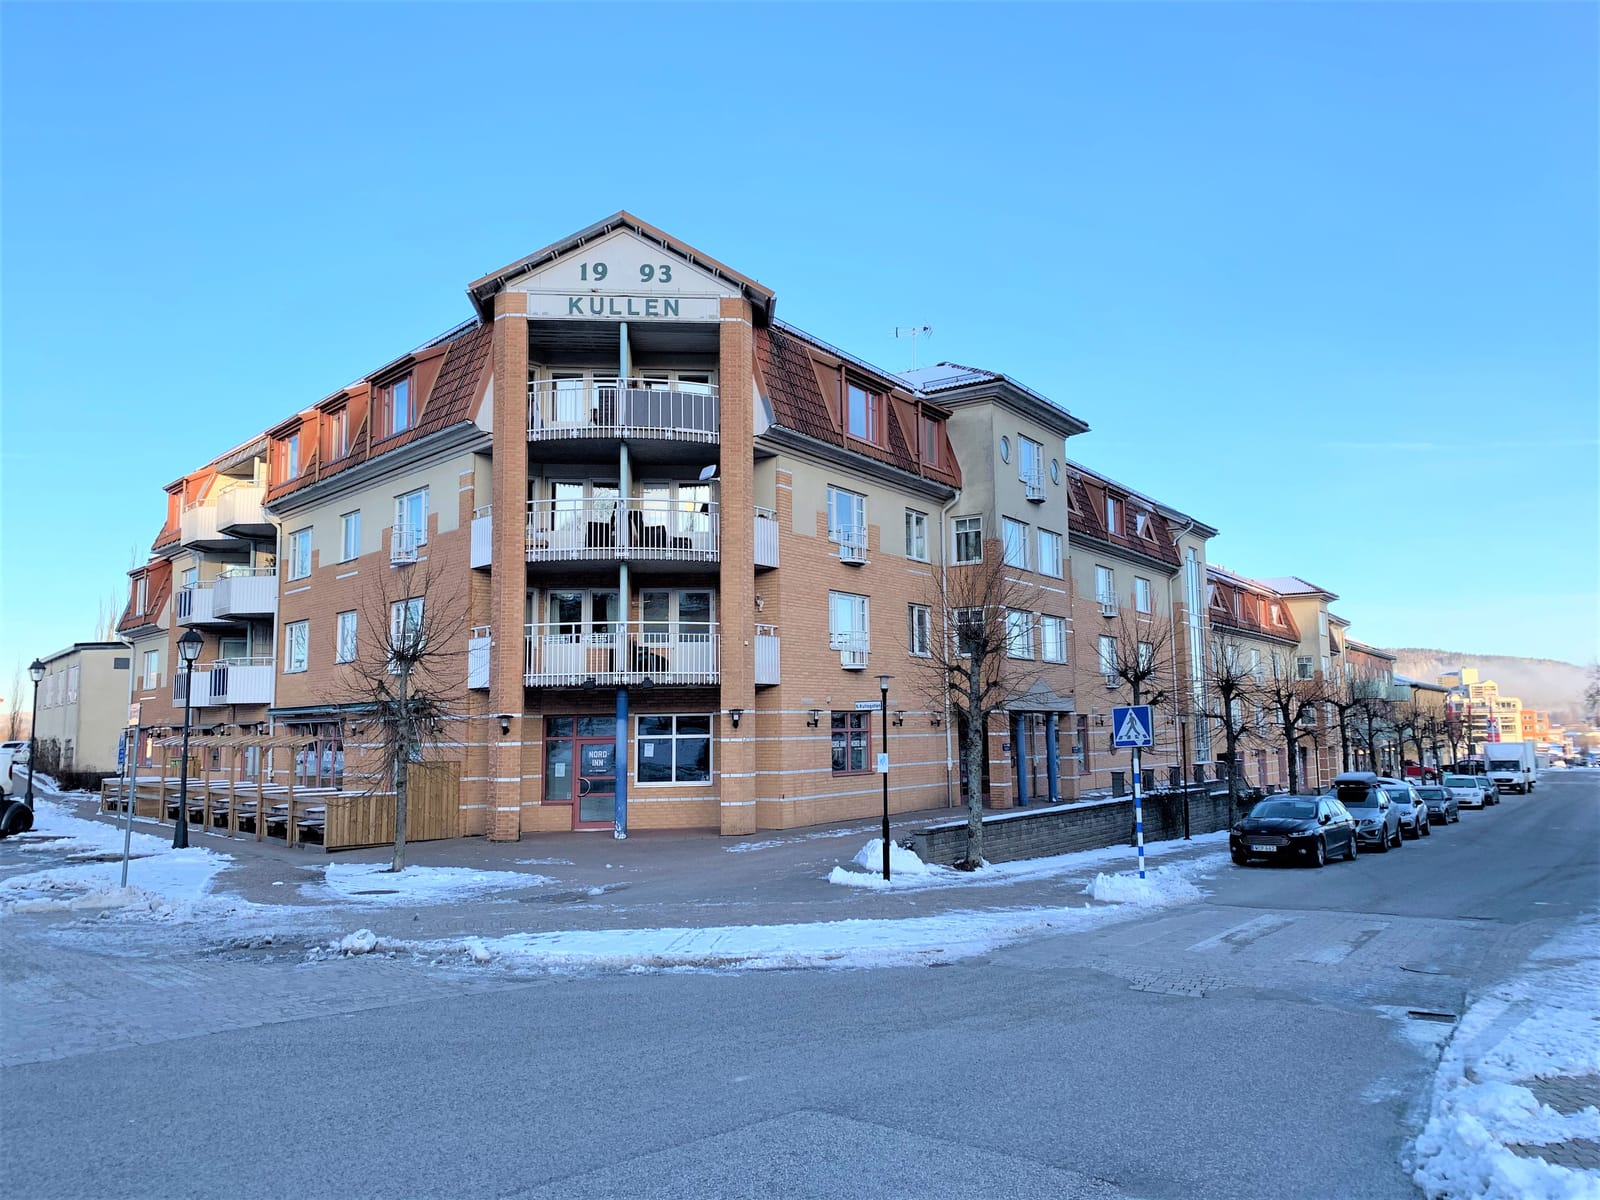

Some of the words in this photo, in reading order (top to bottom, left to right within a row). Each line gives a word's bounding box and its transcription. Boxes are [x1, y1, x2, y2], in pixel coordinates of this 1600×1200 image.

[580, 262, 608, 281] 19
[639, 264, 672, 283] 93
[568, 297, 680, 316] KULLEN
